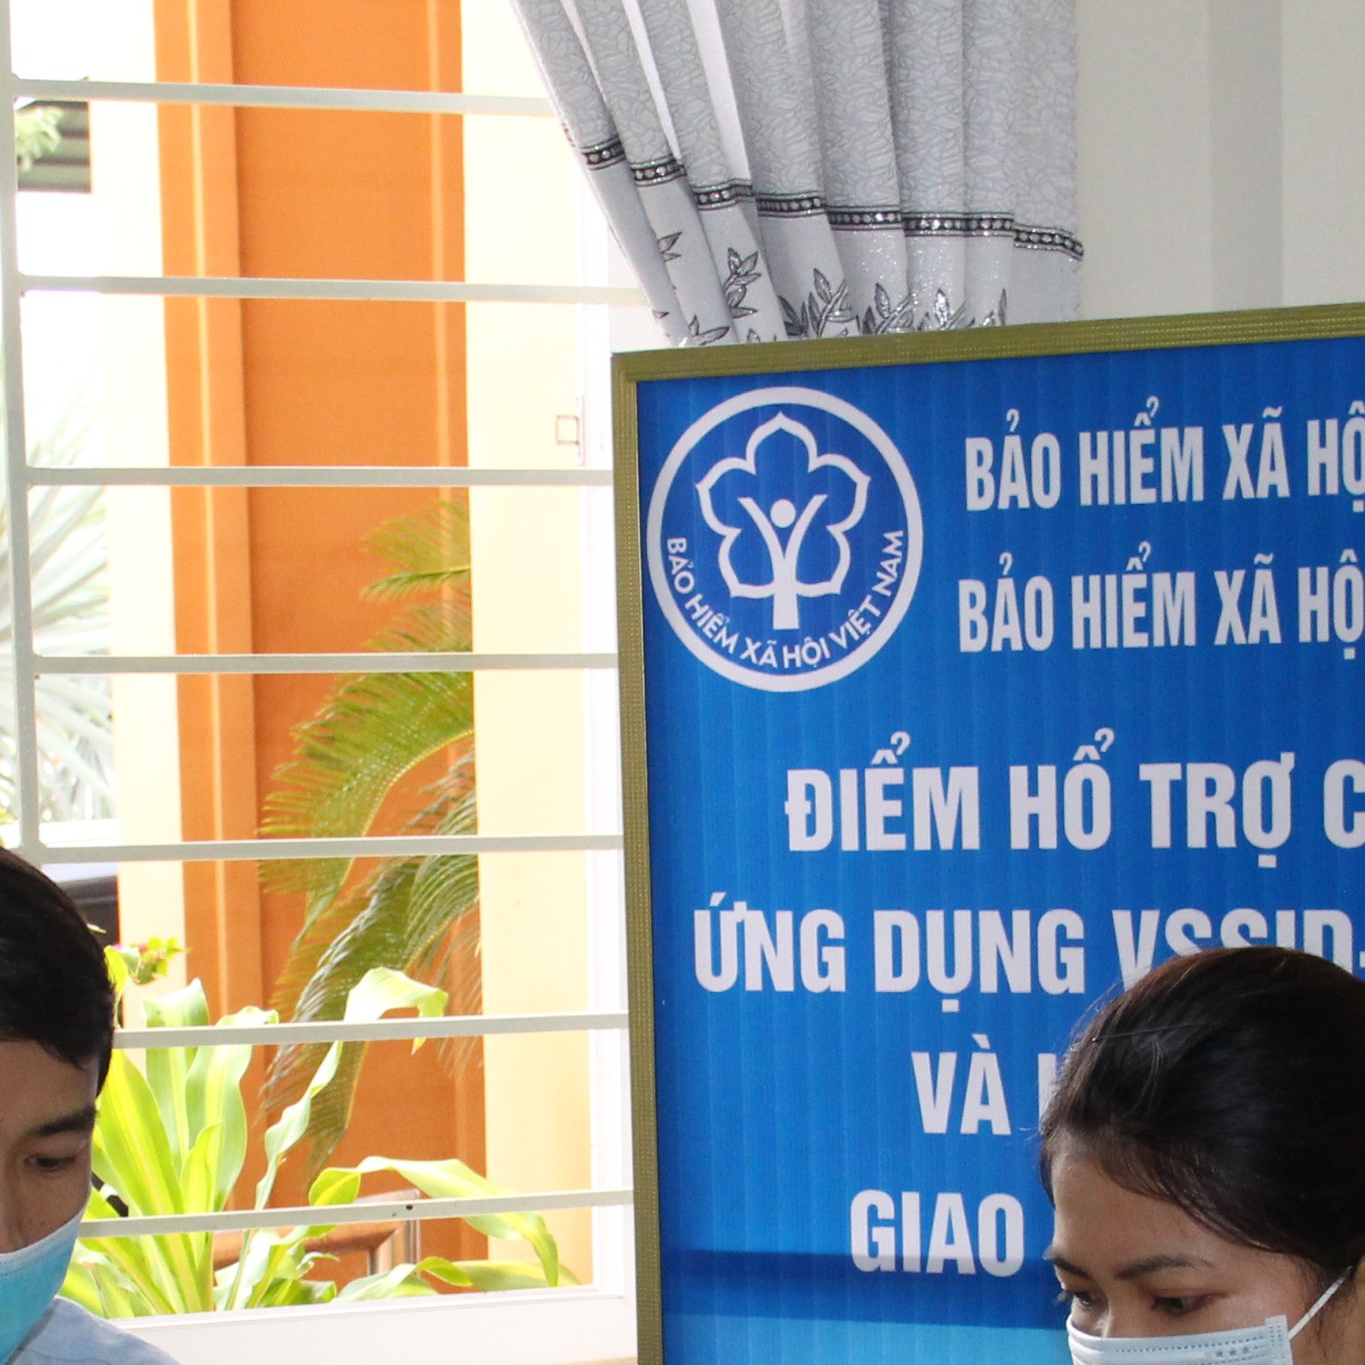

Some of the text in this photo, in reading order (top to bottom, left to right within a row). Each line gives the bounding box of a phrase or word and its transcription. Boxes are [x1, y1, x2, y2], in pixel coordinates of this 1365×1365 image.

[965, 408, 1061, 511] BẢO
[1079, 396, 1204, 505] HIỂM
[1222, 407, 1290, 500] XÃ
[666, 530, 904, 668] BẢO HIỂM XÃ HỘI VIỆT NAM
[958, 552, 1054, 653] BẢO
[1071, 541, 1196, 649] HIỂM
[1214, 553, 1282, 645] XÃ
[784, 731, 981, 851] ĐIỂM
[1009, 727, 1115, 850] HỔ
[1139, 752, 1295, 868] TRỢ
[693, 891, 846, 993] ỨNG
[873, 908, 1085, 1013] DỤNG
[911, 1033, 1012, 1136] VÀ
[850, 1189, 1025, 1277] GIAO
